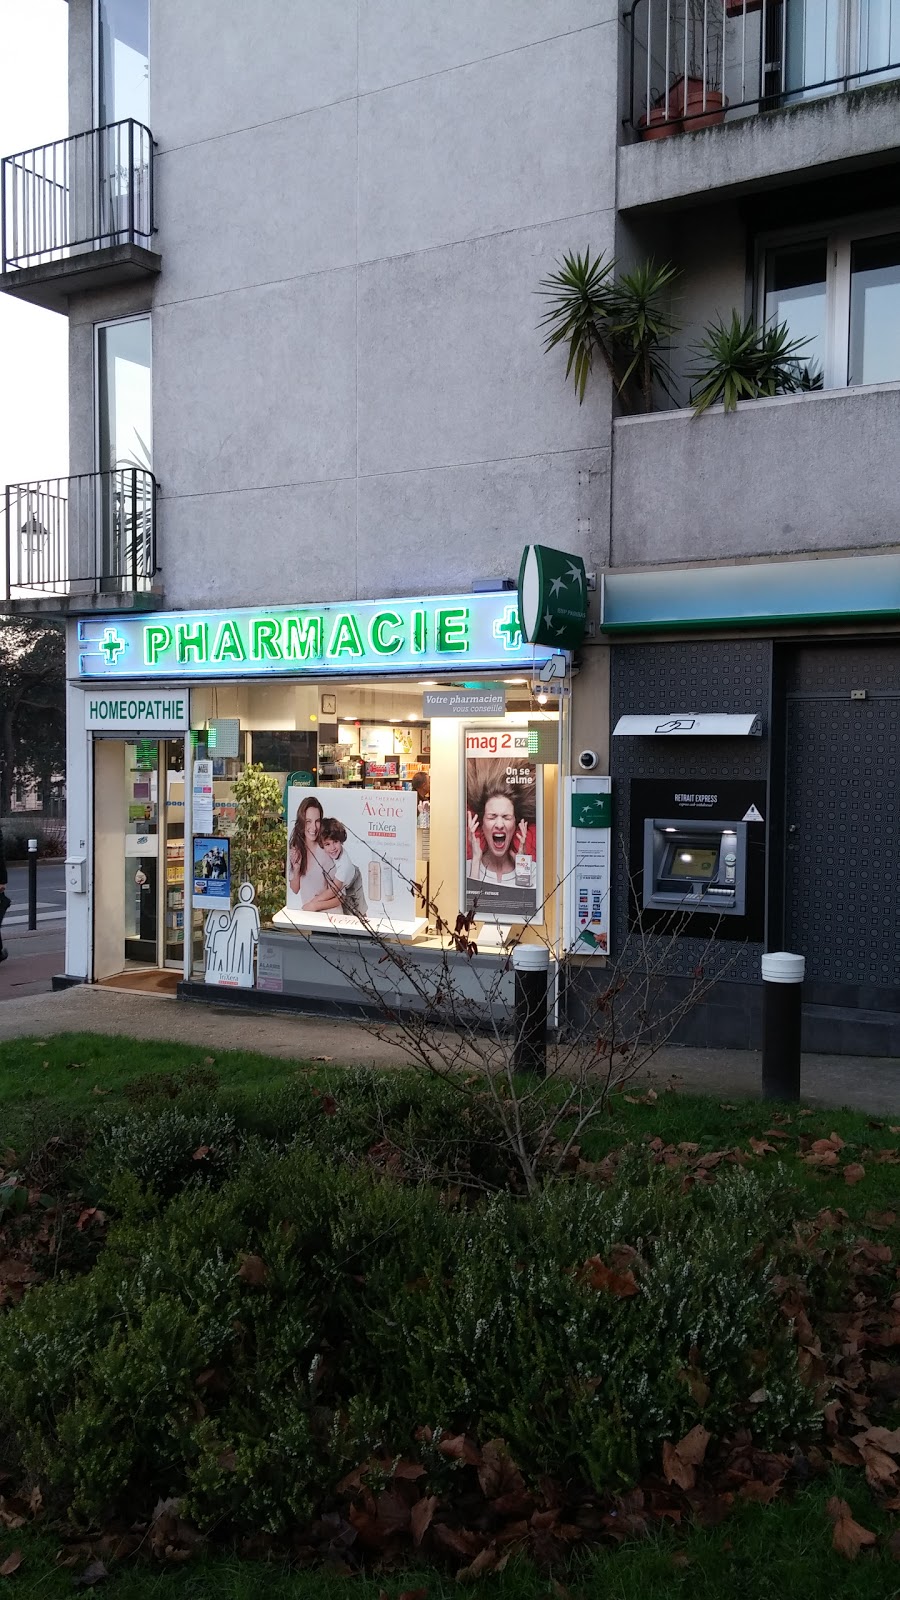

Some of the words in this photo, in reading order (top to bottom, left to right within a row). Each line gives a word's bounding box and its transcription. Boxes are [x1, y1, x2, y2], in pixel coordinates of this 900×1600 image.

[143, 606, 470, 666] PHARMACIE
[426, 695, 448, 704] Votre
[449, 694, 503, 706] pharmacien
[89, 700, 184, 720] HOMEOPATHIE
[452, 705, 469, 713] vous
[470, 704, 503, 713] conseille
[466, 736, 498, 754] mag
[501, 733, 512, 749] 2
[505, 766, 518, 776] On
[519, 768, 530, 776] se
[505, 775, 533, 785] calme
[674, 793, 695, 802] RETRAIT
[695, 794, 718, 803] EXPRESS
[361, 801, 404, 818] Avène
[368, 821, 397, 832] TriXera
